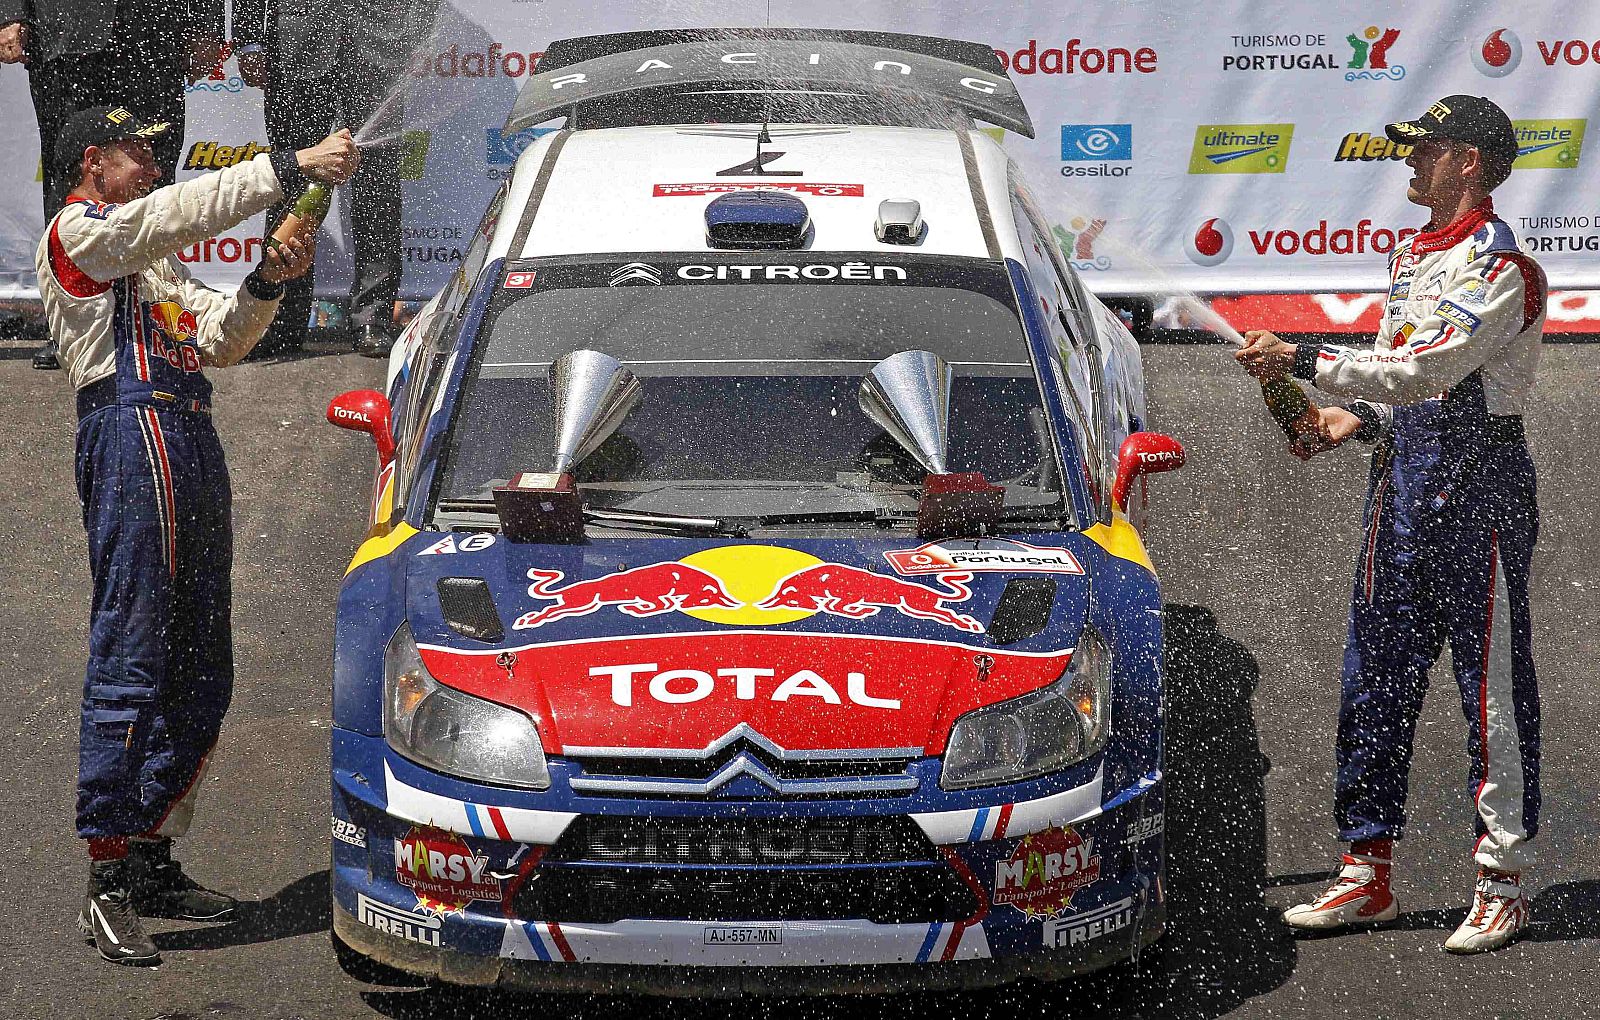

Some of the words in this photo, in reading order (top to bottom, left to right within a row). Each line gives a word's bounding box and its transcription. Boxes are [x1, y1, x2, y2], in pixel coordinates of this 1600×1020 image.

[1231, 35, 1301, 47] TURISMO
[1305, 34, 1326, 46] DE
[1223, 54, 1339, 70] PORTUGAL
[550, 53, 998, 94] RACING
[1204, 131, 1280, 146] ultimate
[1061, 164, 1132, 177] essilor
[1519, 216, 1589, 229] TURISMO
[677, 261, 907, 280] CITROËN
[333, 406, 372, 423] TOTAL
[1137, 451, 1180, 463] TOTAL
[465, 537, 489, 549] E
[904, 562, 950, 571] vodafone
[952, 555, 1069, 566] Portugal
[588, 662, 901, 710] TOTAL
[394, 839, 486, 885] MARSY
[997, 837, 1094, 890] MARSY
[1060, 871, 1099, 892] Logistics
[451, 884, 501, 901] Logistics
[357, 893, 442, 947] PIRELLI
[1042, 896, 1132, 949] PIRELLI
[710, 930, 777, 943] AJ-557-MN
